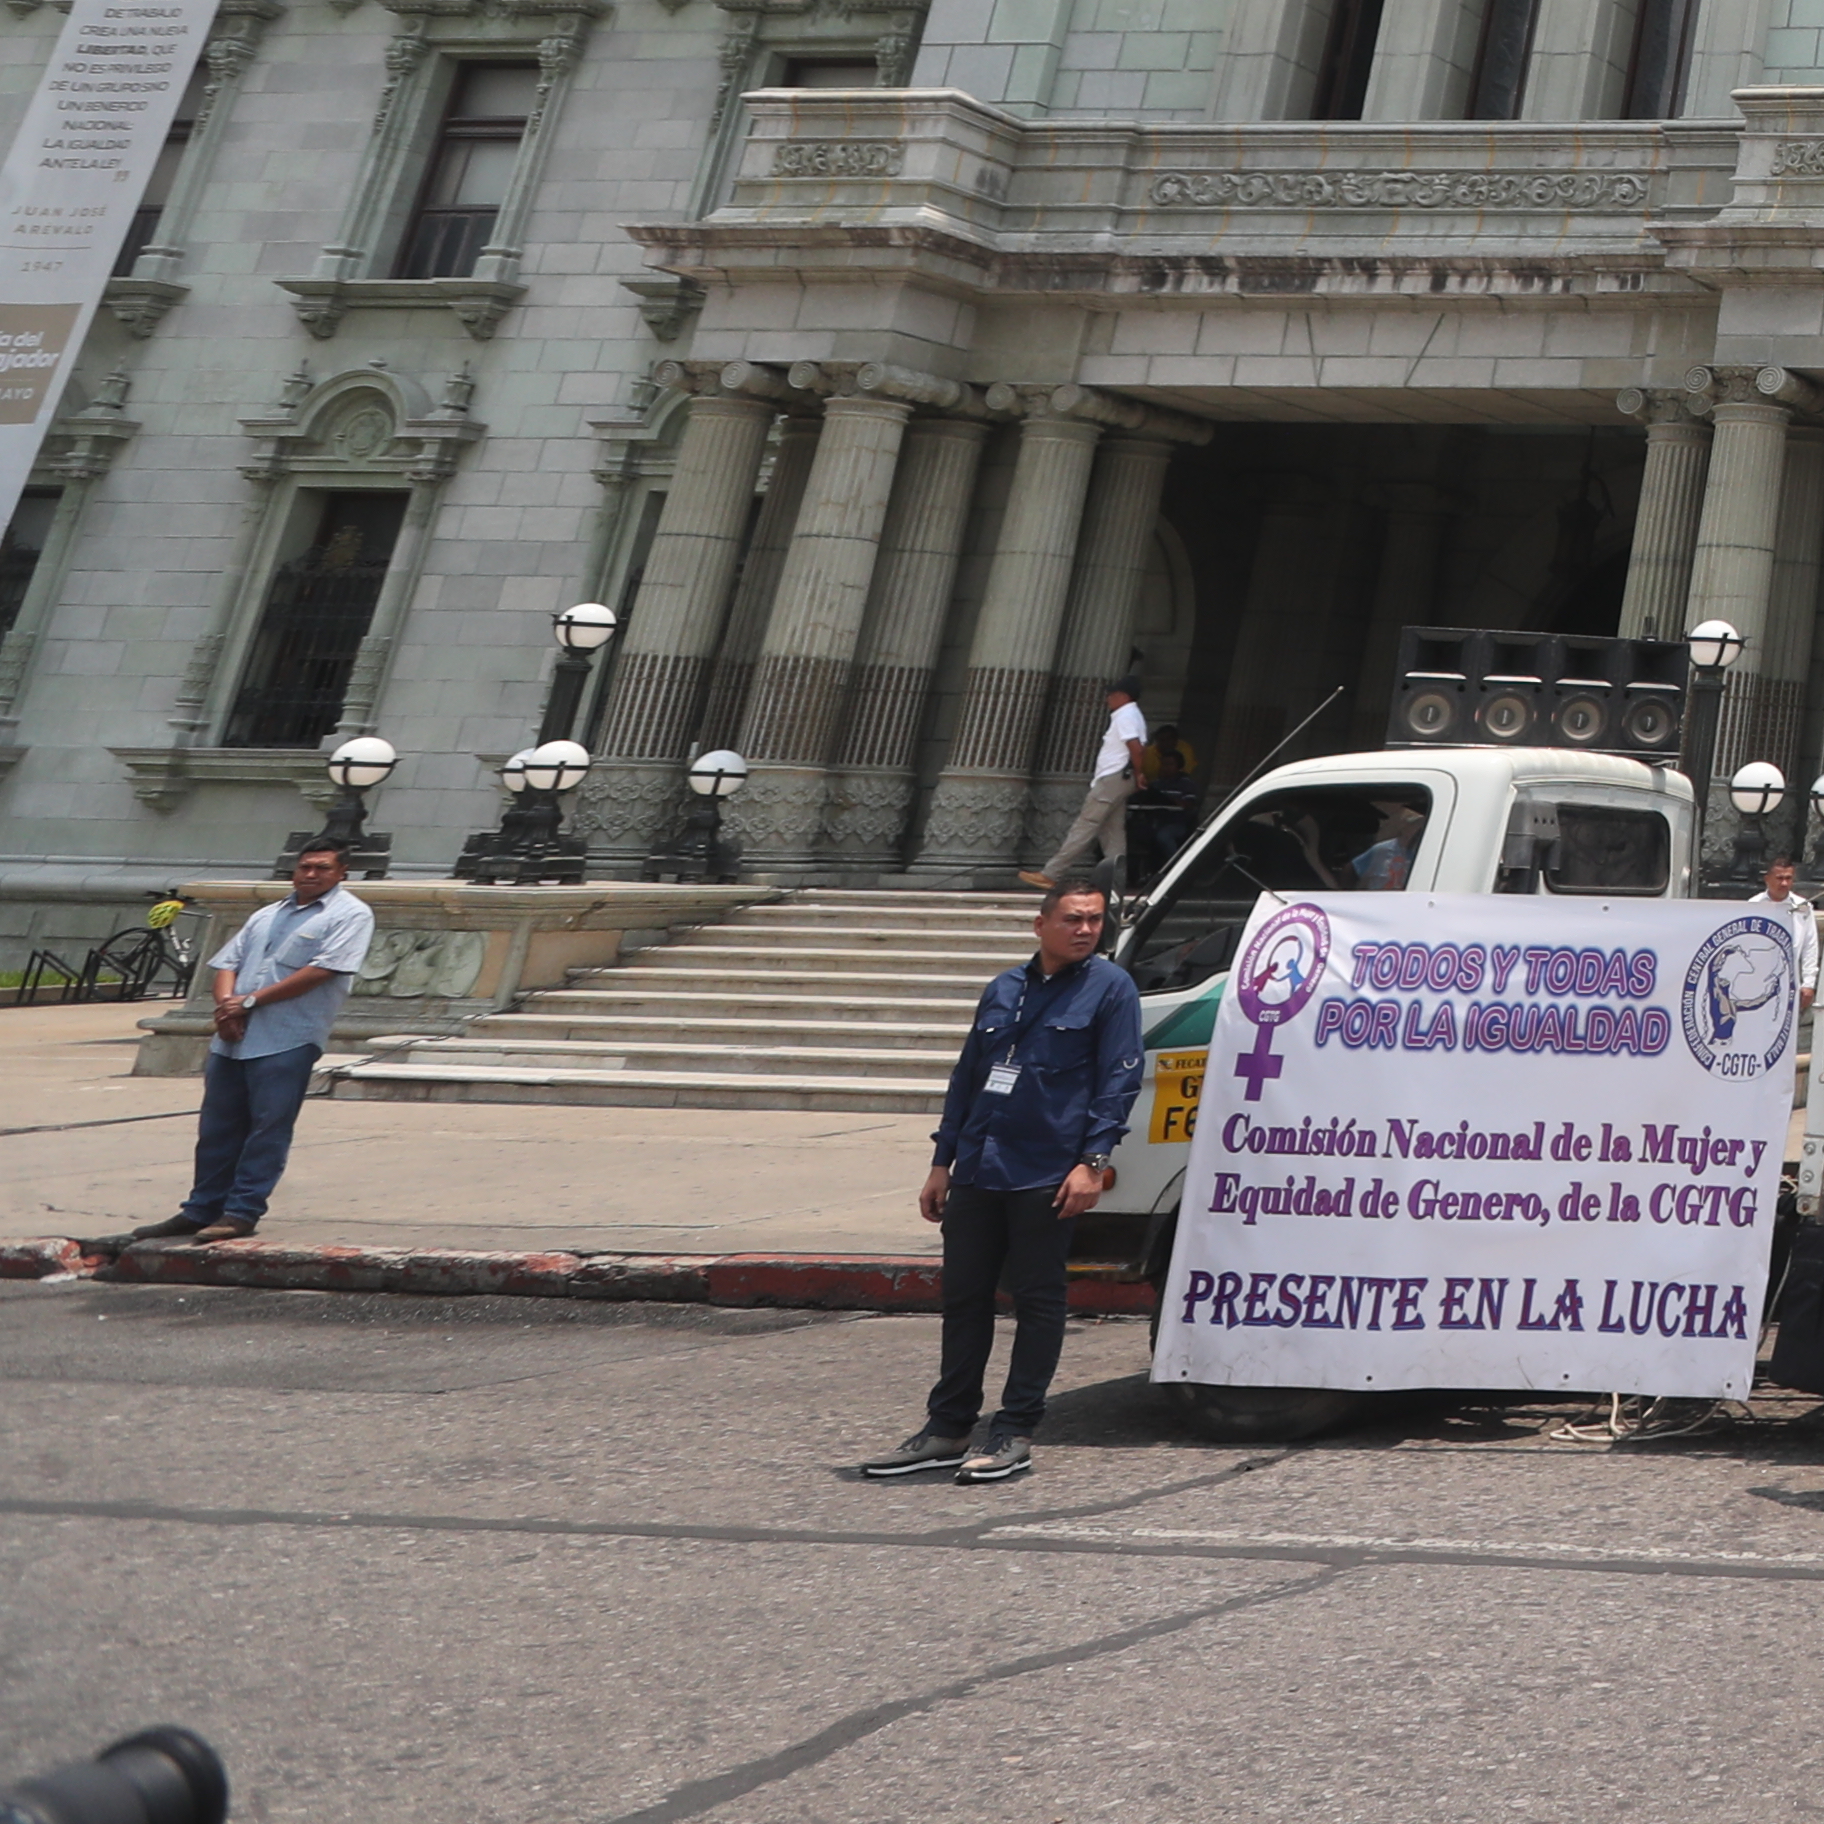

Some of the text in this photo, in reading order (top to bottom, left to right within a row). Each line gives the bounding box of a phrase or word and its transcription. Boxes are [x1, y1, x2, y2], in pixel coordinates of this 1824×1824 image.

[11, 206, 64, 216] JUAN
[14, 331, 44, 347] del
[0, 387, 33, 400] AYO
[1351, 942, 1657, 998] TODOS Y TODAS
[1687, 941, 1713, 985] CENTRAL
[1711, 920, 1748, 947] GENERAL
[1751, 919, 1763, 930] DE
[1313, 999, 1672, 1055] POR LA IGUALDAD
[1222, 1113, 1767, 1178] Comisión Nacional de la Mujer y
[1208, 1173, 1758, 1227] Equidad de Genero, de la CGTG
[1181, 1270, 1749, 1339] PRESENTE EN LA LUCHA
